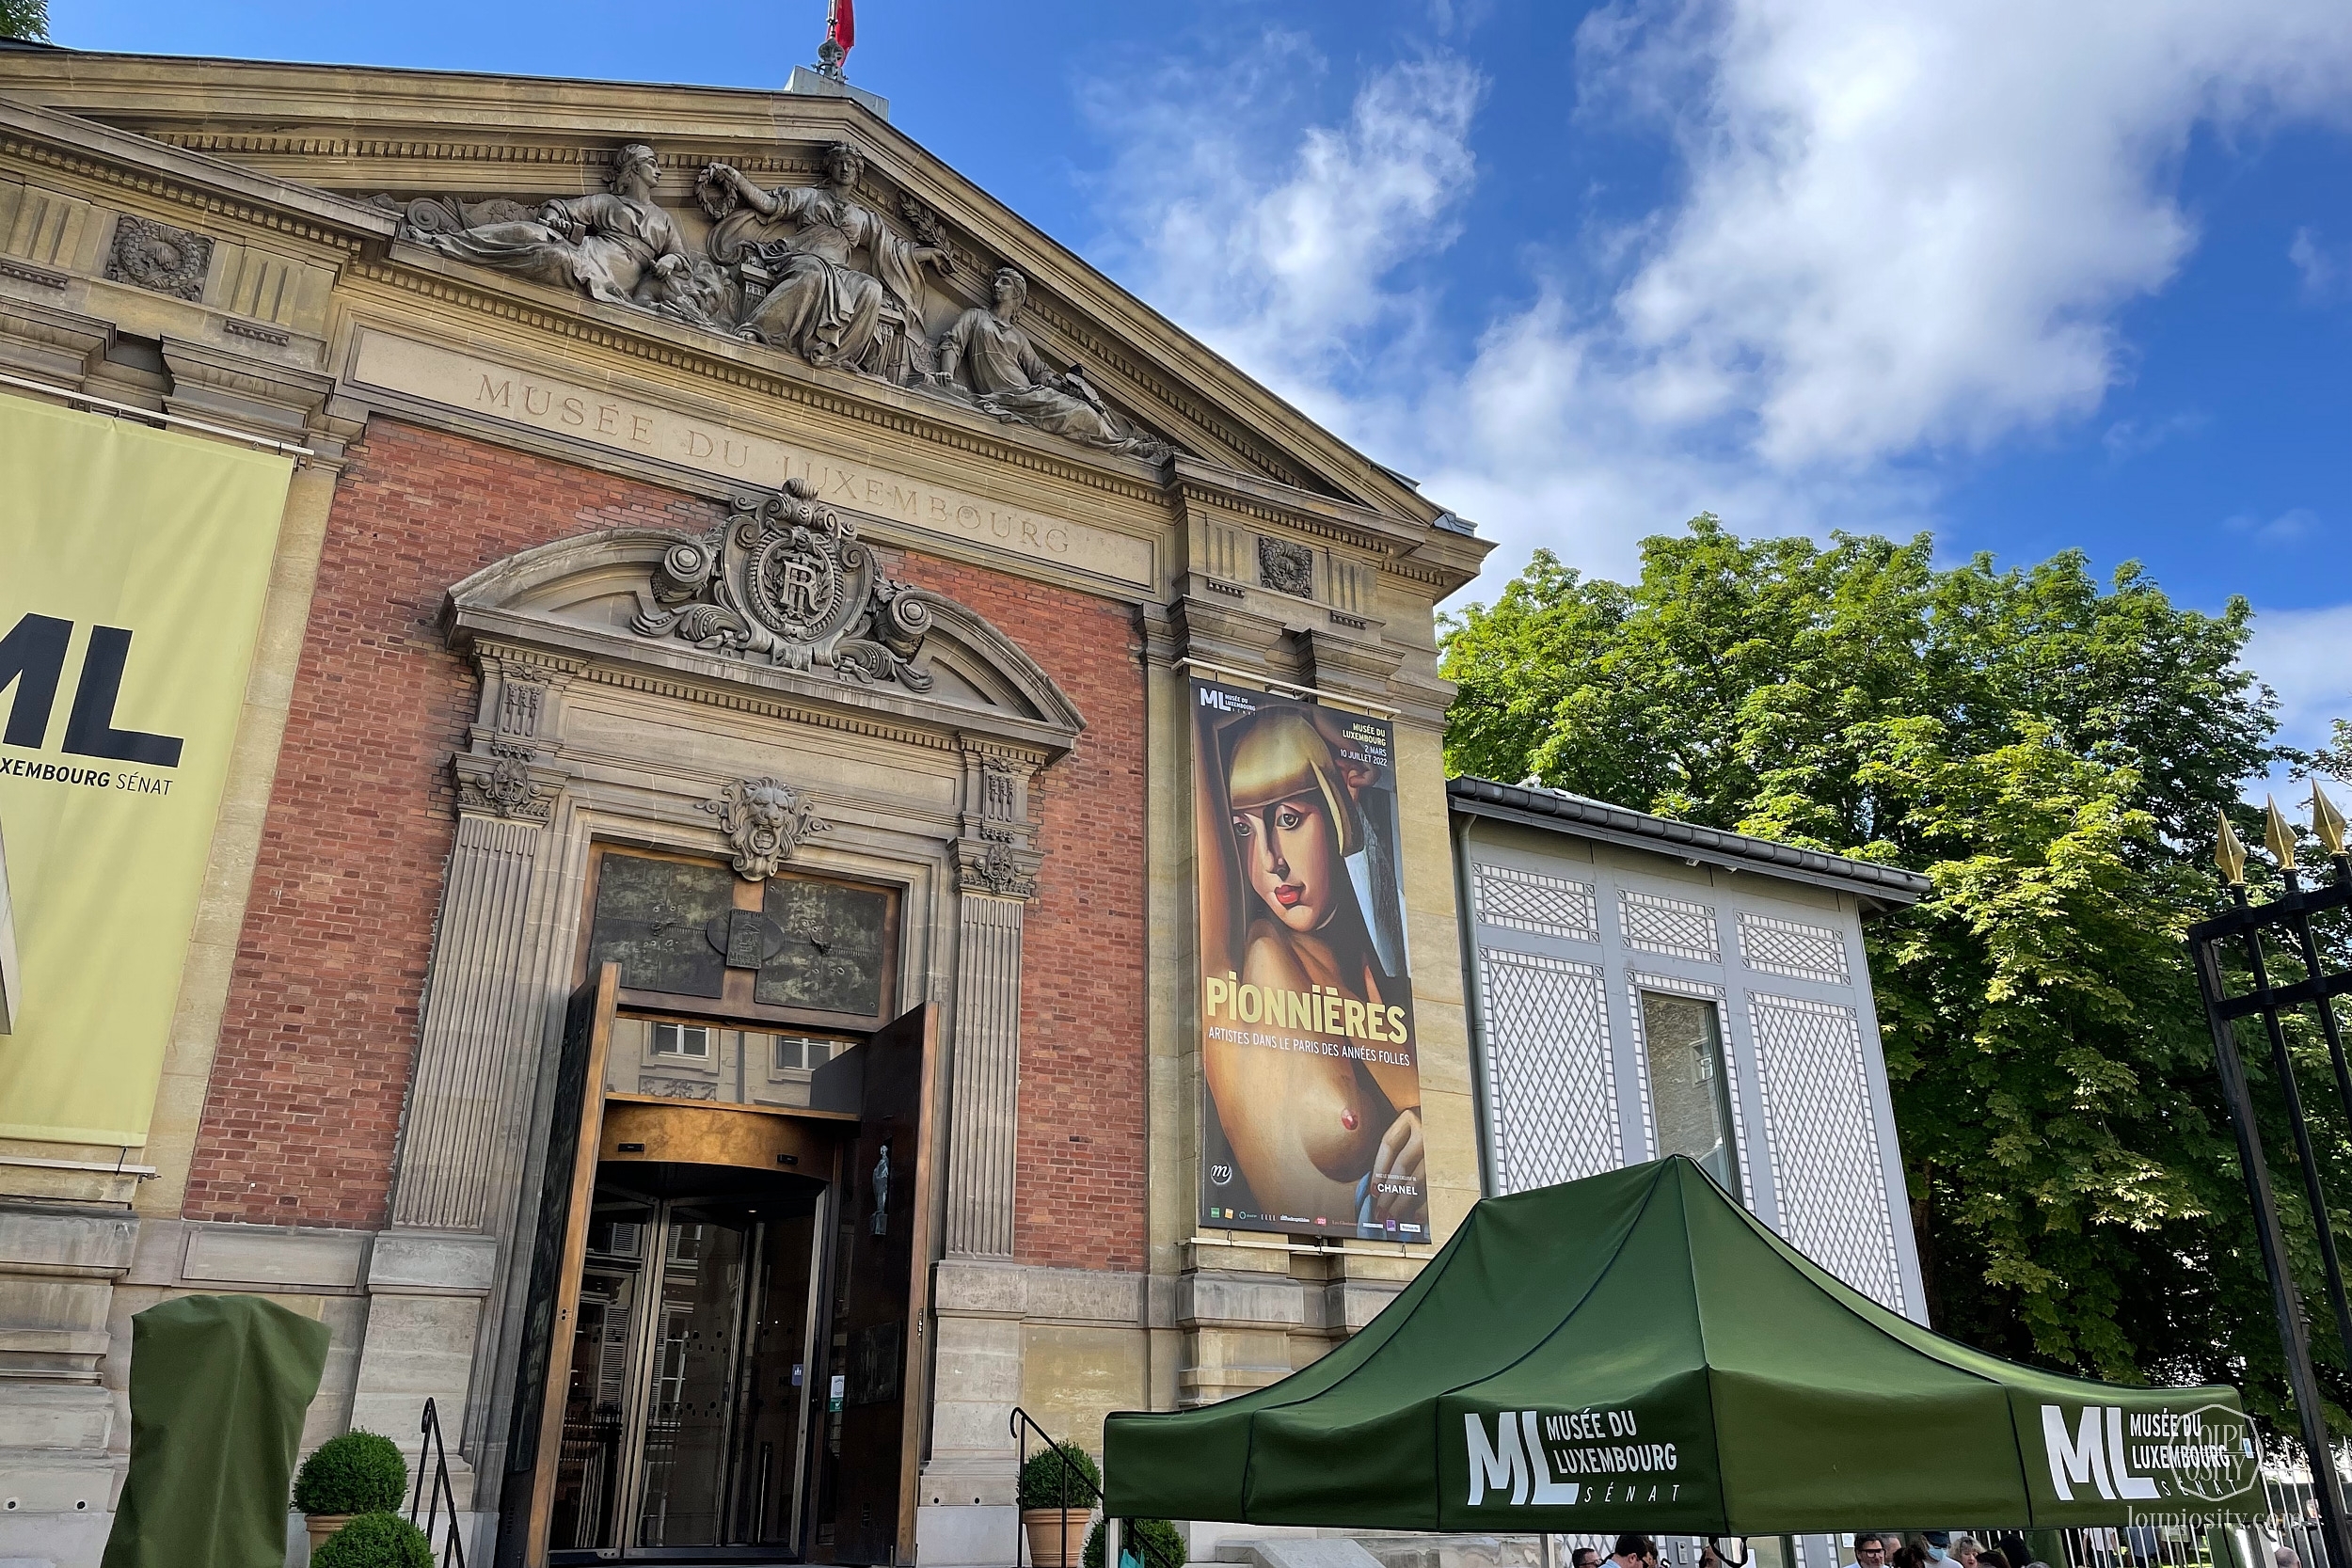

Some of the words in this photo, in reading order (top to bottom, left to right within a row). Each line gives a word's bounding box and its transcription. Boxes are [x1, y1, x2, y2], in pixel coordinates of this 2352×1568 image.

[475, 374, 654, 444] MUSÉE
[687, 429, 749, 468] DU
[1200, 687, 1232, 712] ML
[1343, 729, 1387, 747] LUXEMBOURG
[1352, 722, 1375, 735] MUSÉE
[1375, 728, 1386, 737] DU
[1340, 749, 1347, 758] 10
[1347, 751, 1372, 763] JUILLET
[1373, 756, 1388, 767] 2022
[1364, 745, 1369, 753] 2
[1370, 746, 1388, 757] MARS
[116, 771, 173, 796] SÉNAT
[1208, 1026, 1249, 1045] ARTISTES
[1252, 1033, 1277, 1049] DANS
[1279, 1037, 1291, 1051] LE
[1293, 1039, 1319, 1054] PARIS
[1322, 1043, 1339, 1056] DES
[1342, 1044, 1376, 1062] ANNÉES
[1378, 1050, 1410, 1067] FOLLES
[1377, 1183, 1418, 1196] CHANEL
[1546, 1408, 1605, 1441] MUSÉE
[1608, 1410, 1637, 1436] DU
[2129, 1408, 2180, 1437] MUSÉE
[2183, 1414, 2201, 1437] DU
[1464, 1411, 1580, 1505] ML
[1553, 1443, 1677, 1474] LUXEMBOURG
[2041, 1404, 2161, 1500] ML
[2132, 1445, 2231, 1469] LUXEMBOURG
